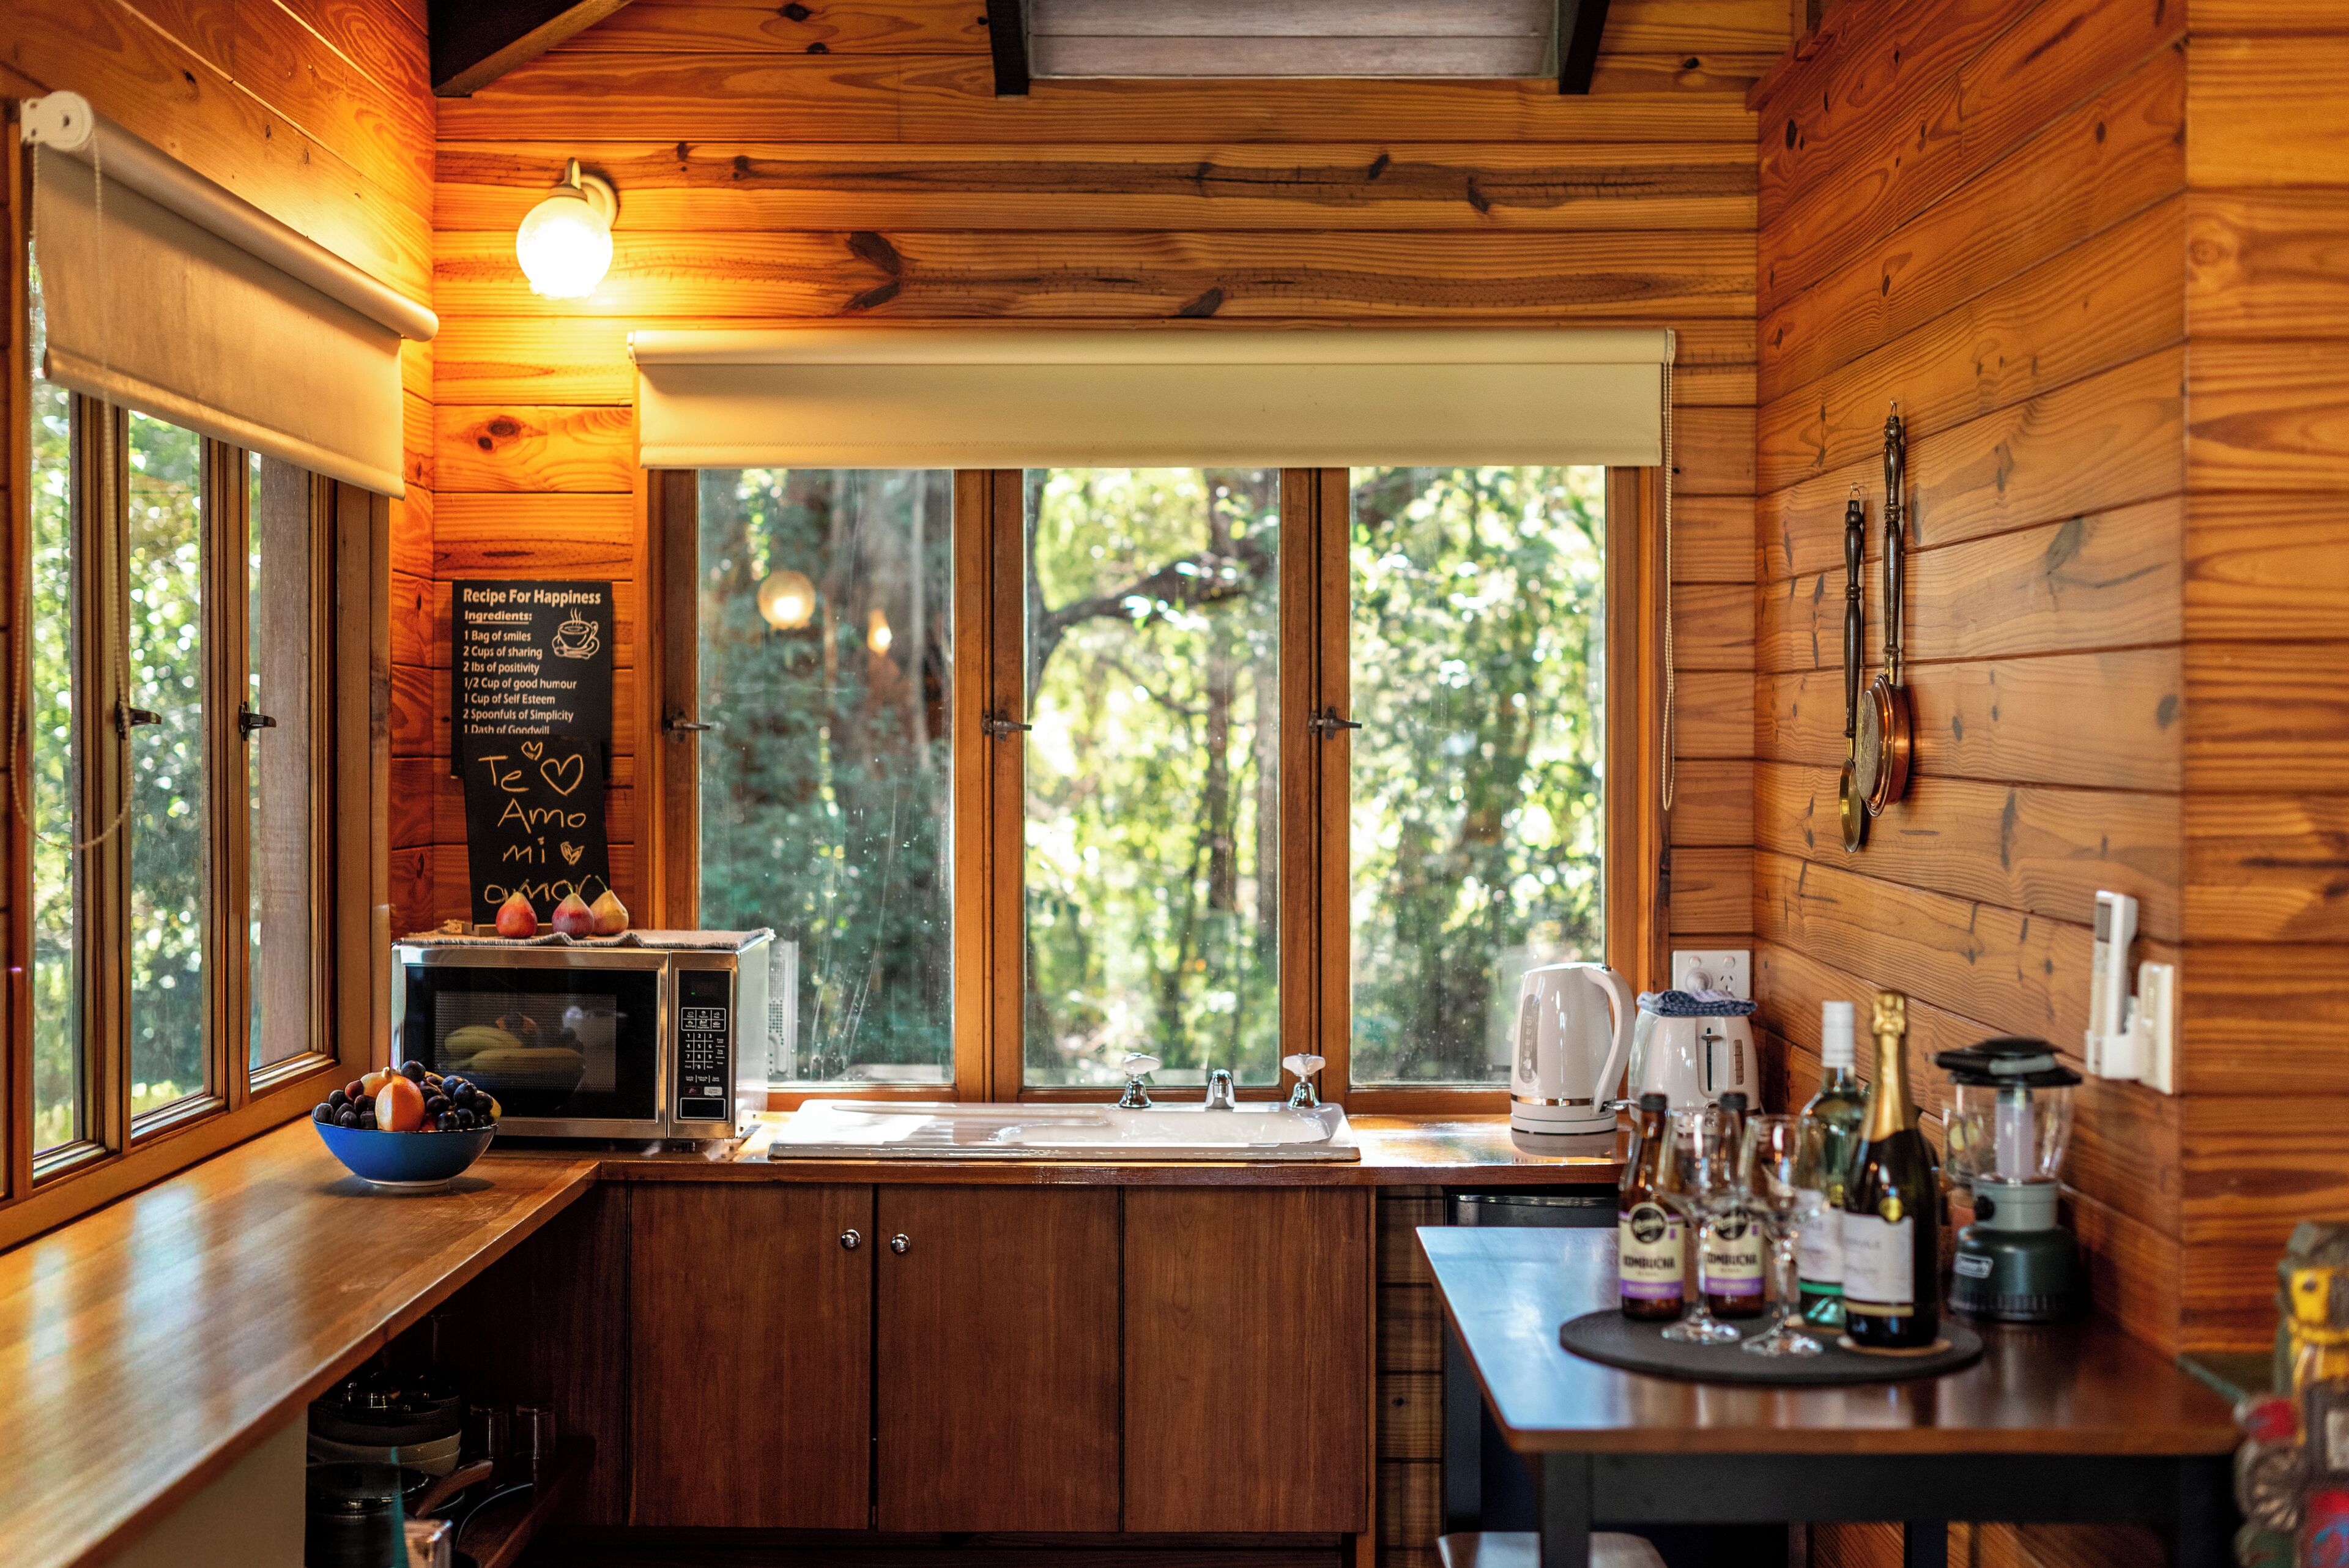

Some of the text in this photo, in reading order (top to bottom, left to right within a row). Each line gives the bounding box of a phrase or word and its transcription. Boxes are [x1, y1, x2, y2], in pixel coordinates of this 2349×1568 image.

[464, 588, 601, 608] Recipe For Happiness
[465, 610, 532, 622] Ingredients:
[464, 630, 531, 644] 1 Bag of smiles
[463, 645, 543, 660] 2 Cups of sharing
[463, 661, 540, 675] 2 lbs of positivity
[464, 677, 577, 691] 1/2 Cup of good humour
[464, 693, 555, 705] 1 Cup of Self Esteem
[463, 708, 574, 723] 2 Spoonfuls of Simplicity
[464, 724, 549, 734] 1 Dash of Goodwill
[478, 755, 529, 792] Te
[497, 798, 586, 833] Amo
